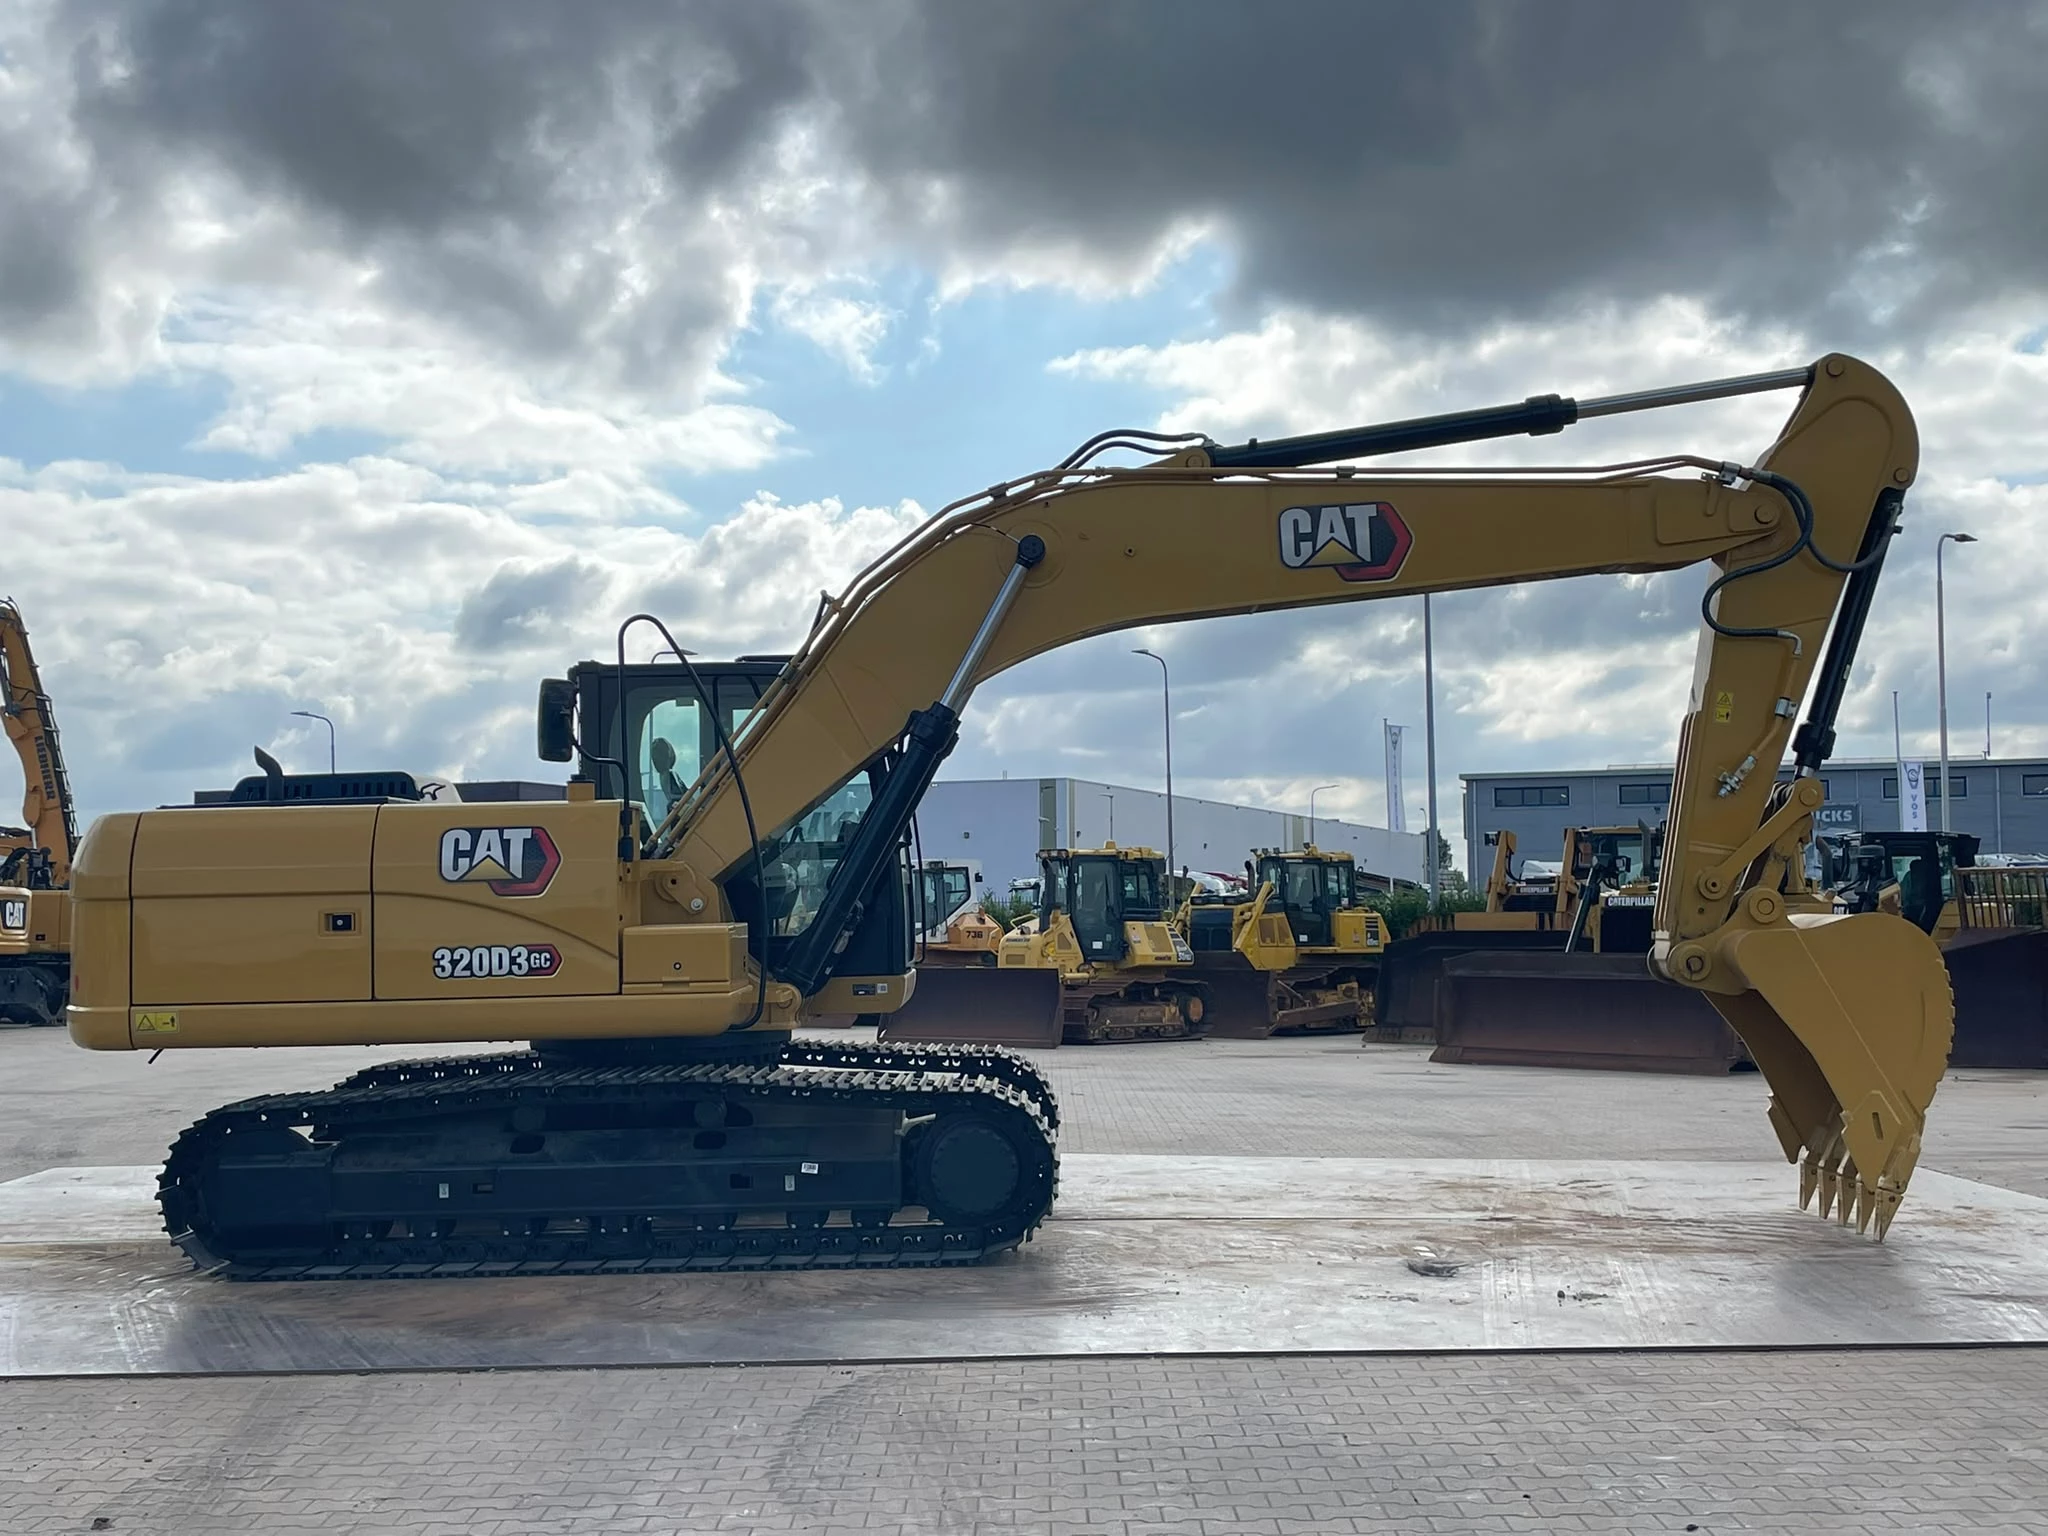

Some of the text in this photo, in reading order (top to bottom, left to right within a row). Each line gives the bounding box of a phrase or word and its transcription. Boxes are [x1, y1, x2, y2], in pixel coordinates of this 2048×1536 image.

[1279, 503, 1378, 567] CAT
[441, 828, 533, 881] CAT
[5, 901, 25, 928] CAT
[433, 946, 550, 978] 320D3 GC
